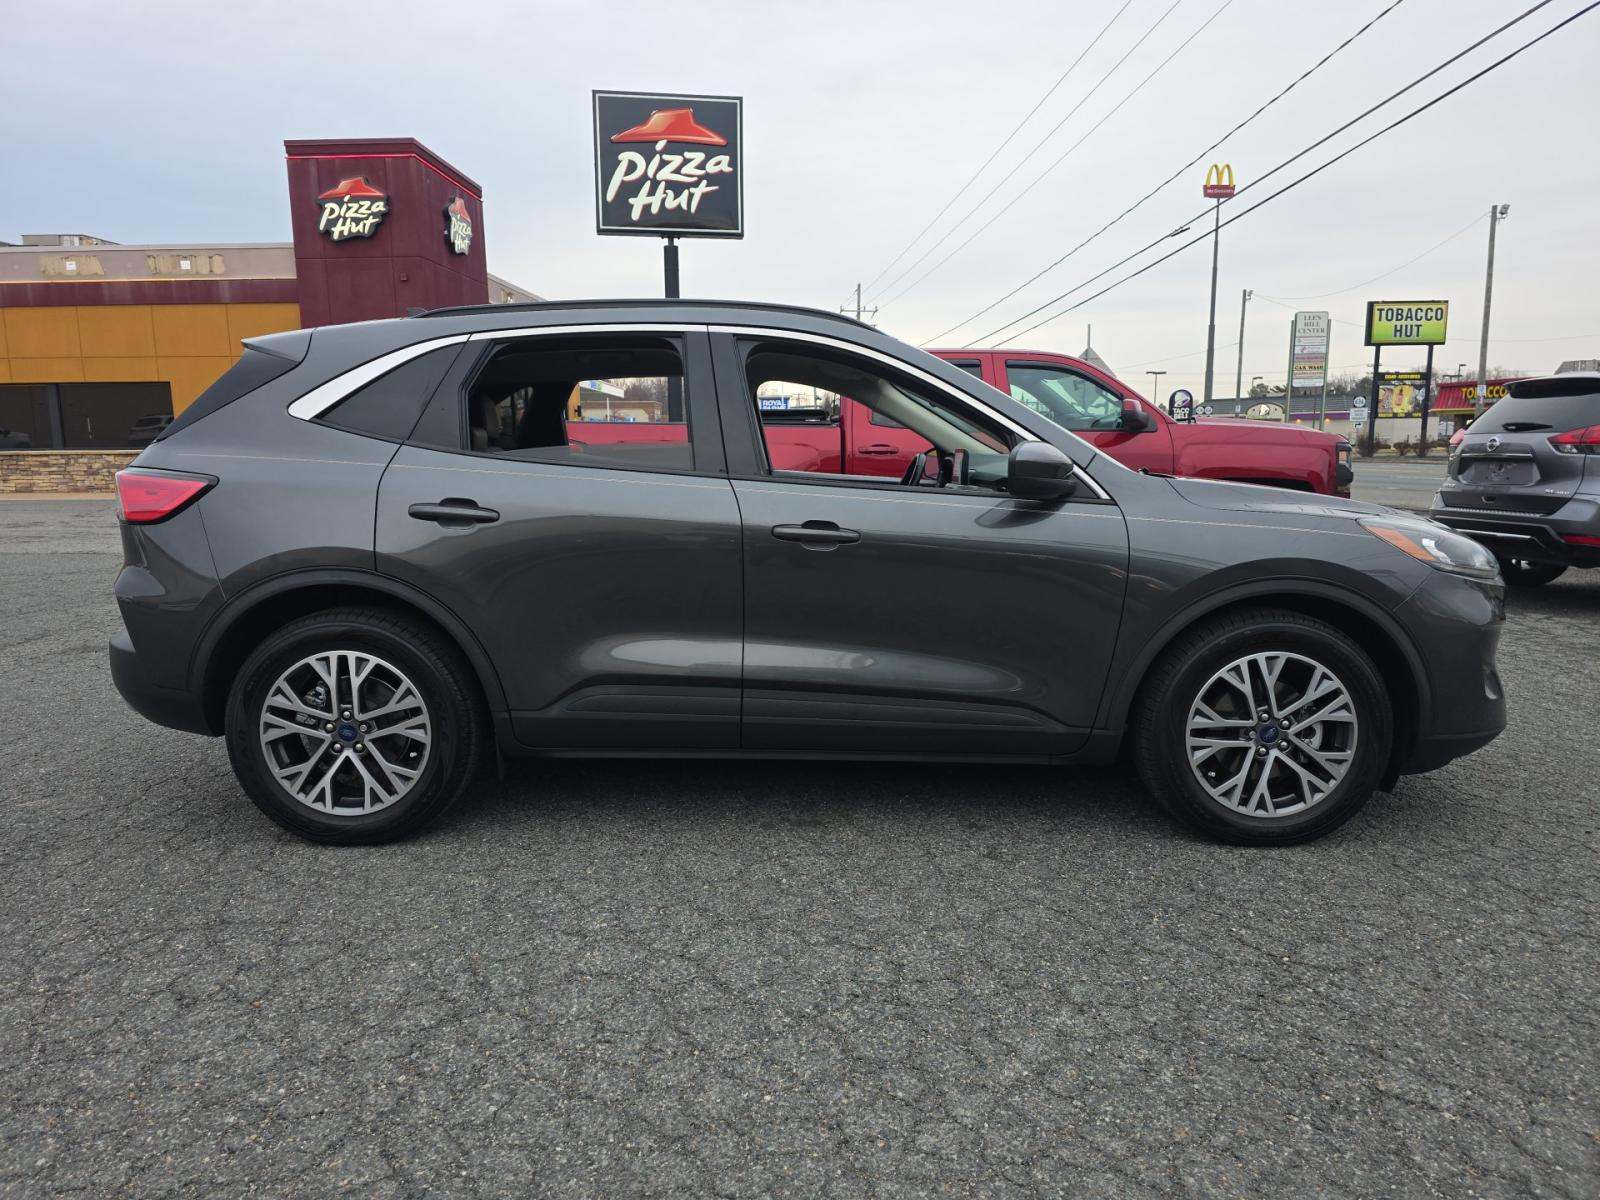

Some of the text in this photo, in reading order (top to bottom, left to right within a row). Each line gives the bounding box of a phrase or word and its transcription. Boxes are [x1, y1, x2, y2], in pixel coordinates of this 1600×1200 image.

[628, 180, 719, 221] Hut
[331, 217, 381, 240] Hut
[454, 233, 471, 252] Hut
[1376, 307, 1444, 322] TOBACCO
[1393, 324, 1423, 338] HUT
[1460, 386, 1508, 399] TOCCO
